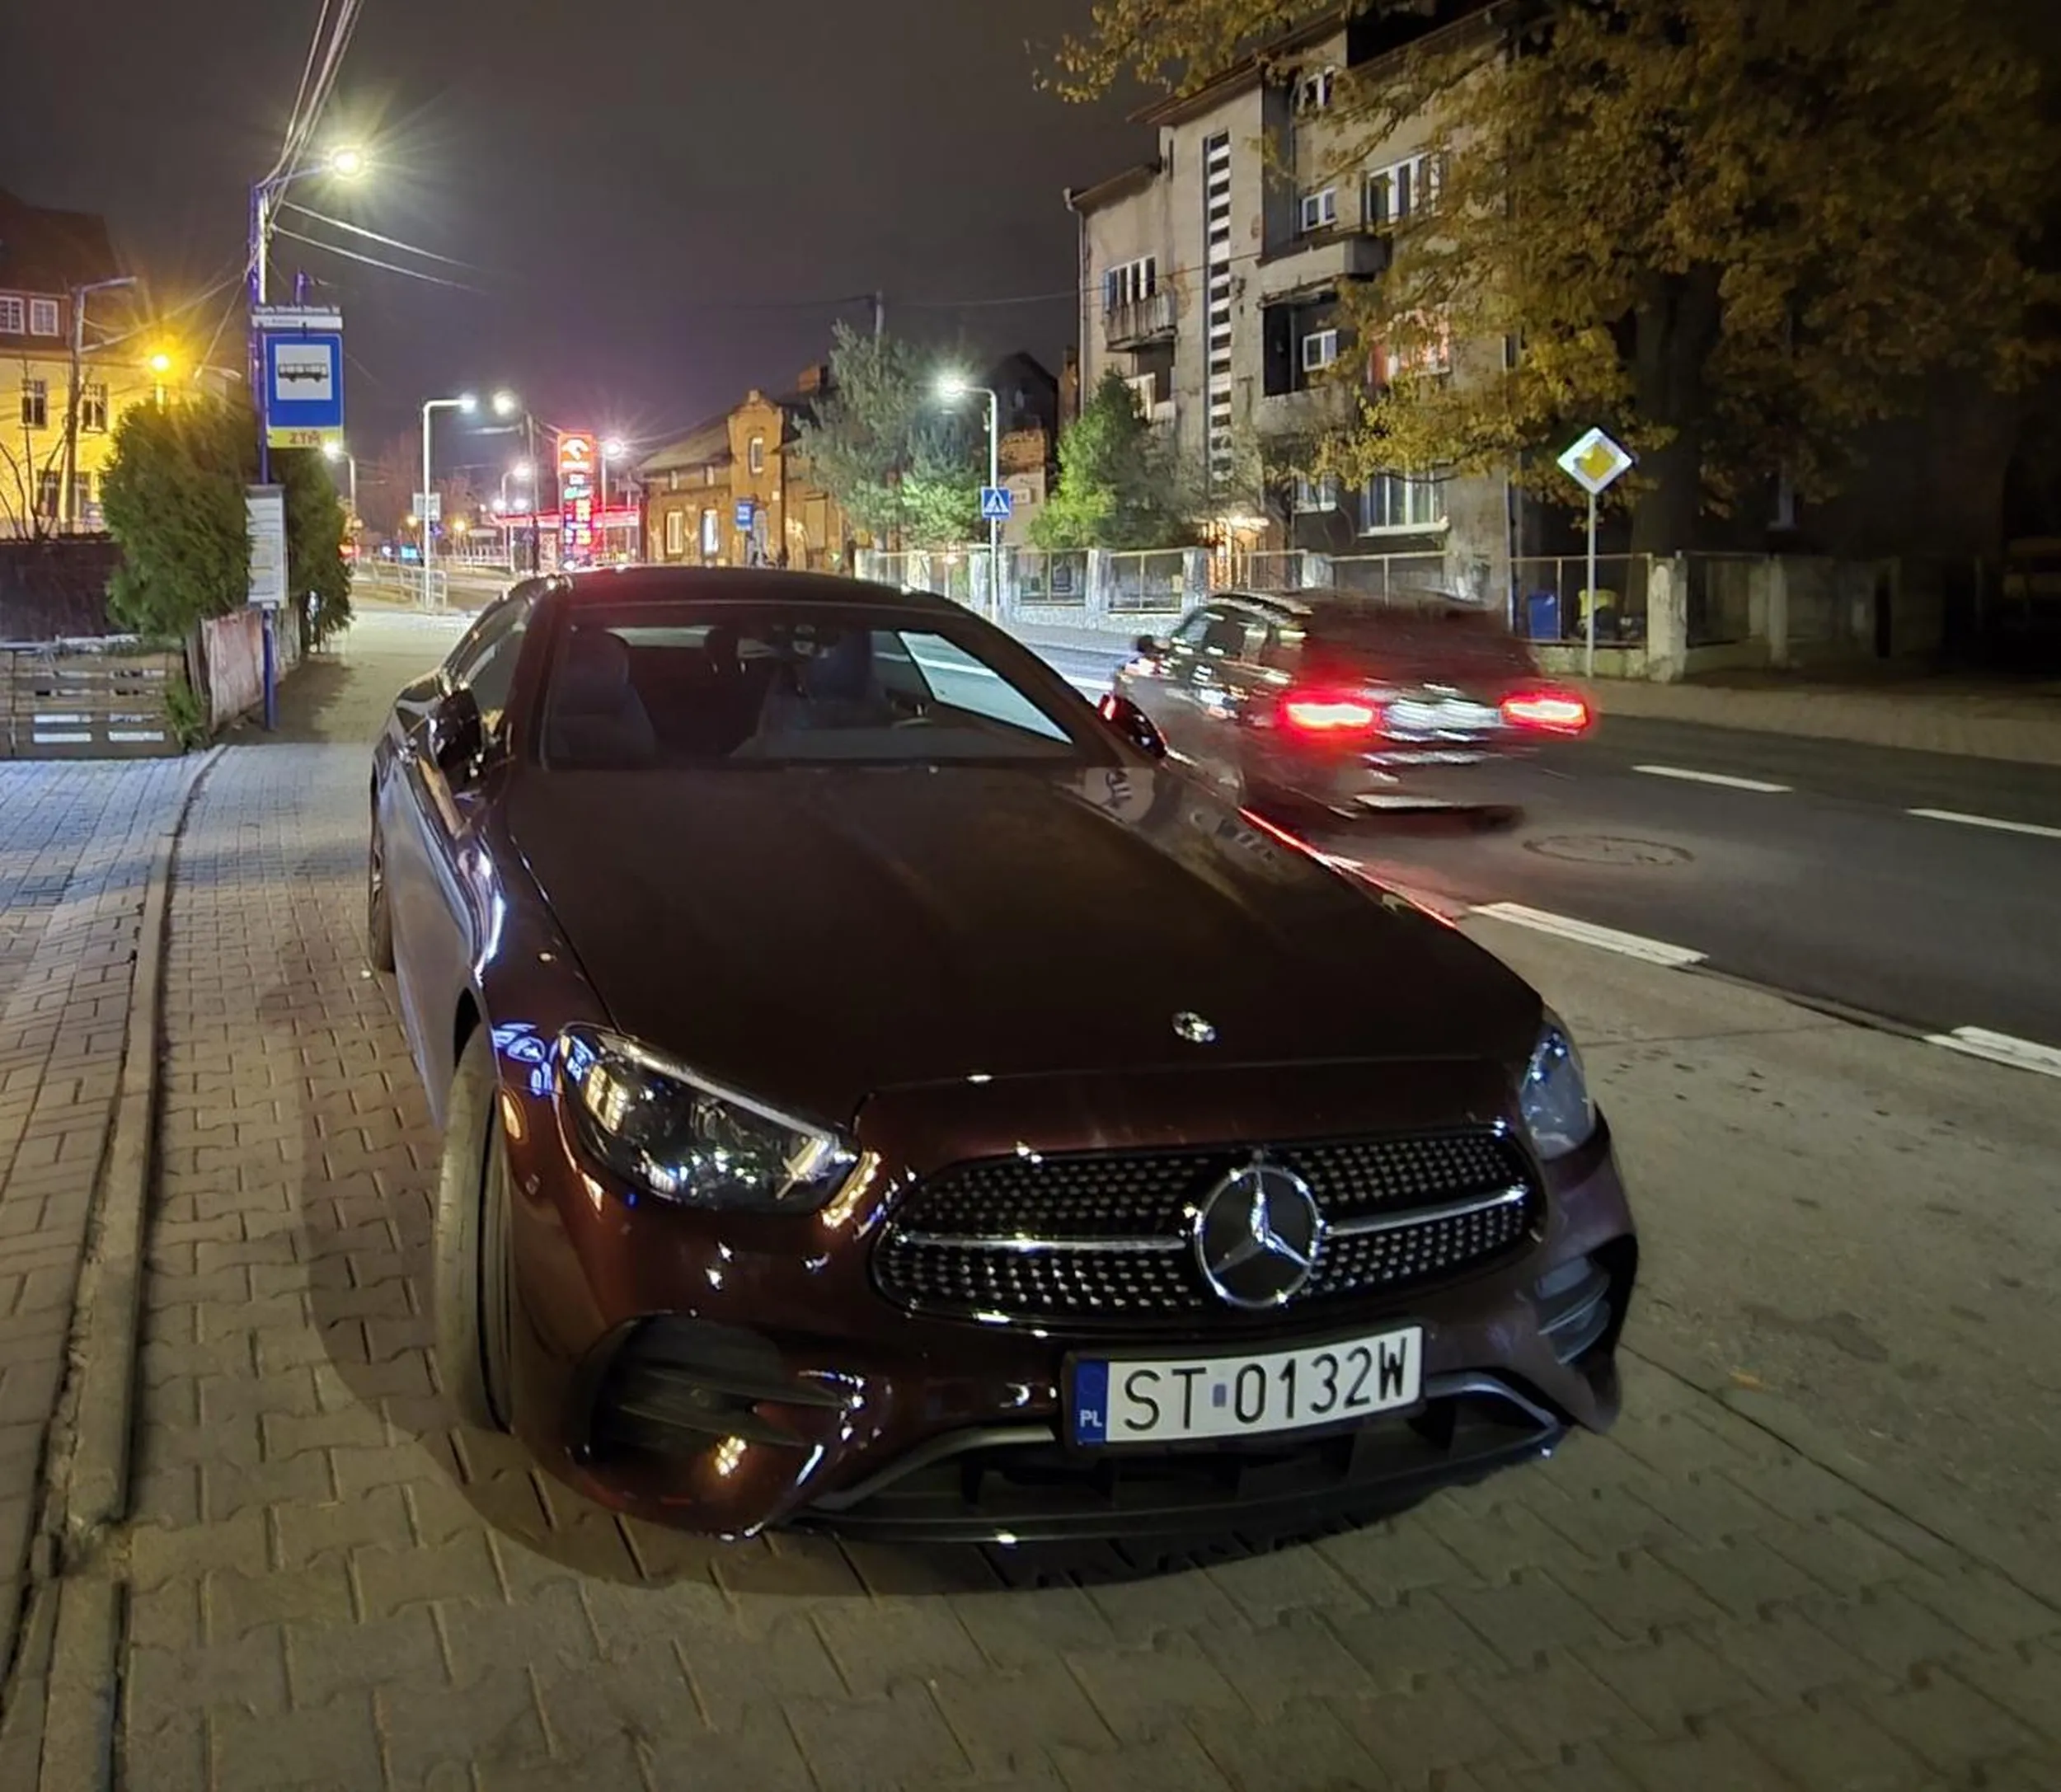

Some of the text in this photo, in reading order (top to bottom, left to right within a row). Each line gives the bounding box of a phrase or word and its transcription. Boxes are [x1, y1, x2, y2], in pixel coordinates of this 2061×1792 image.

[1123, 1337, 1408, 1431] ST 0132W
[1080, 1409, 1103, 1428] PL
